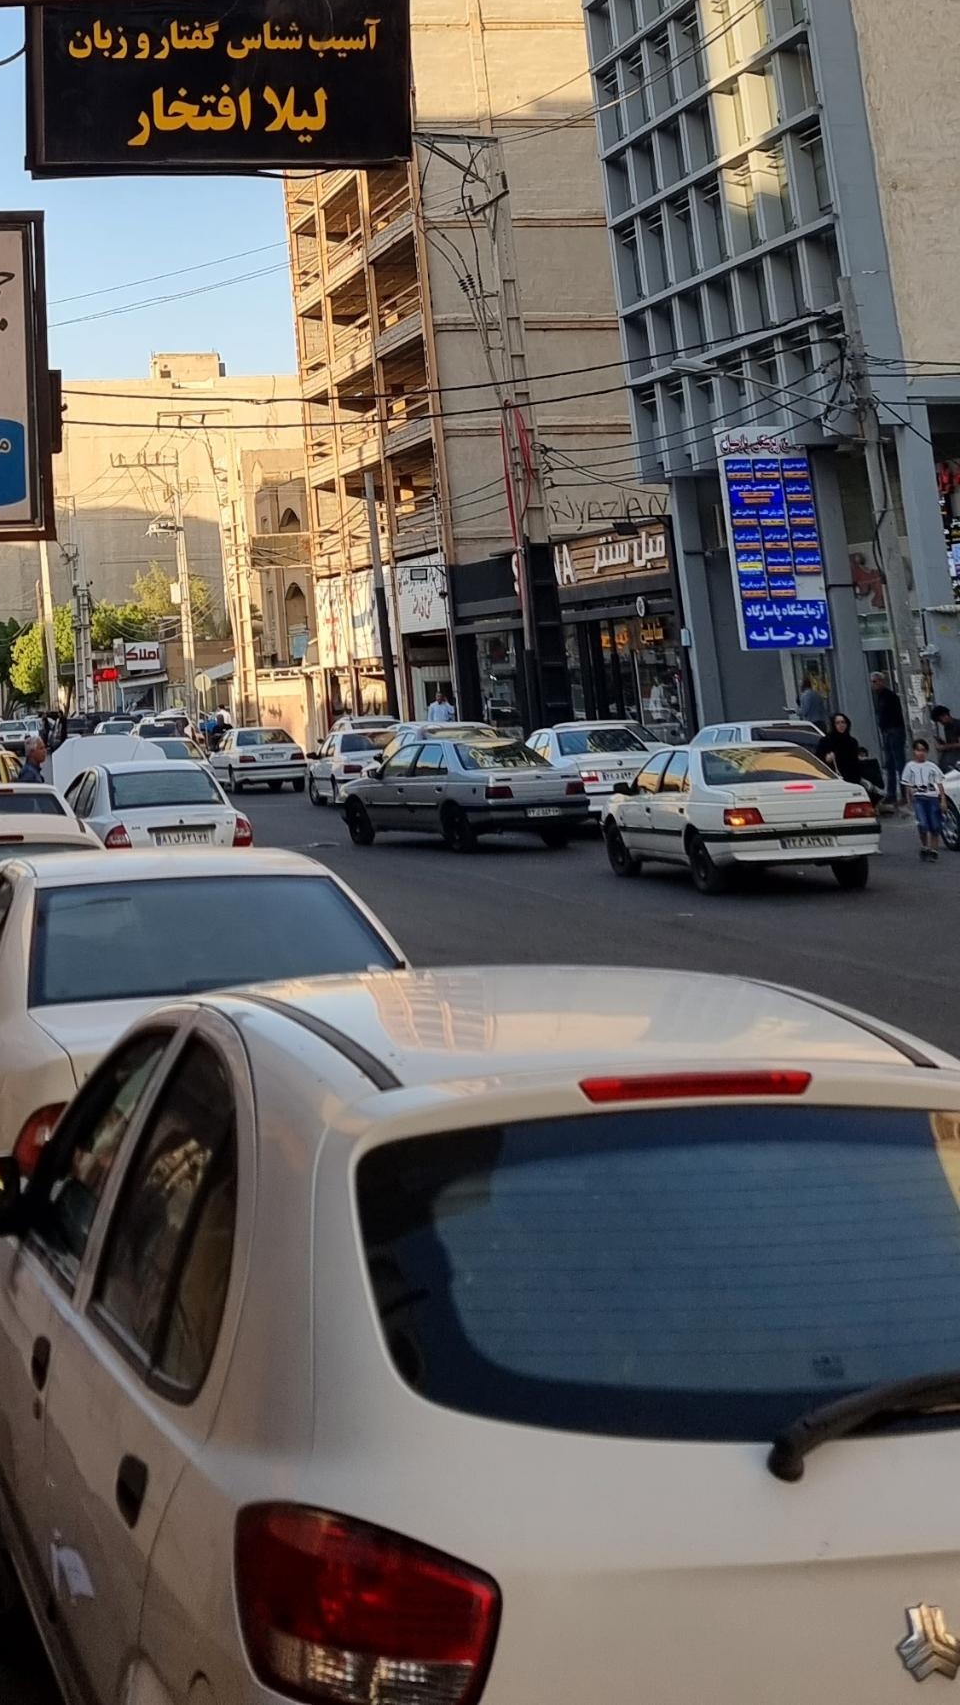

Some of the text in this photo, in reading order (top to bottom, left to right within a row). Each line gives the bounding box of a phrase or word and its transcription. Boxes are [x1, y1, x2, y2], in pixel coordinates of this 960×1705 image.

[68, 17, 382, 60] آسیب شناس گفتار و زبان
[127, 82, 328, 146] لیلا افتخار
[591, 535, 630, 575] سنتر
[632, 530, 666, 570] مبل
[745, 600, 826, 622] آزمایشگاه پاسارگاد
[125, 646, 160, 662] املاک
[749, 625, 828, 645] داروخانه
